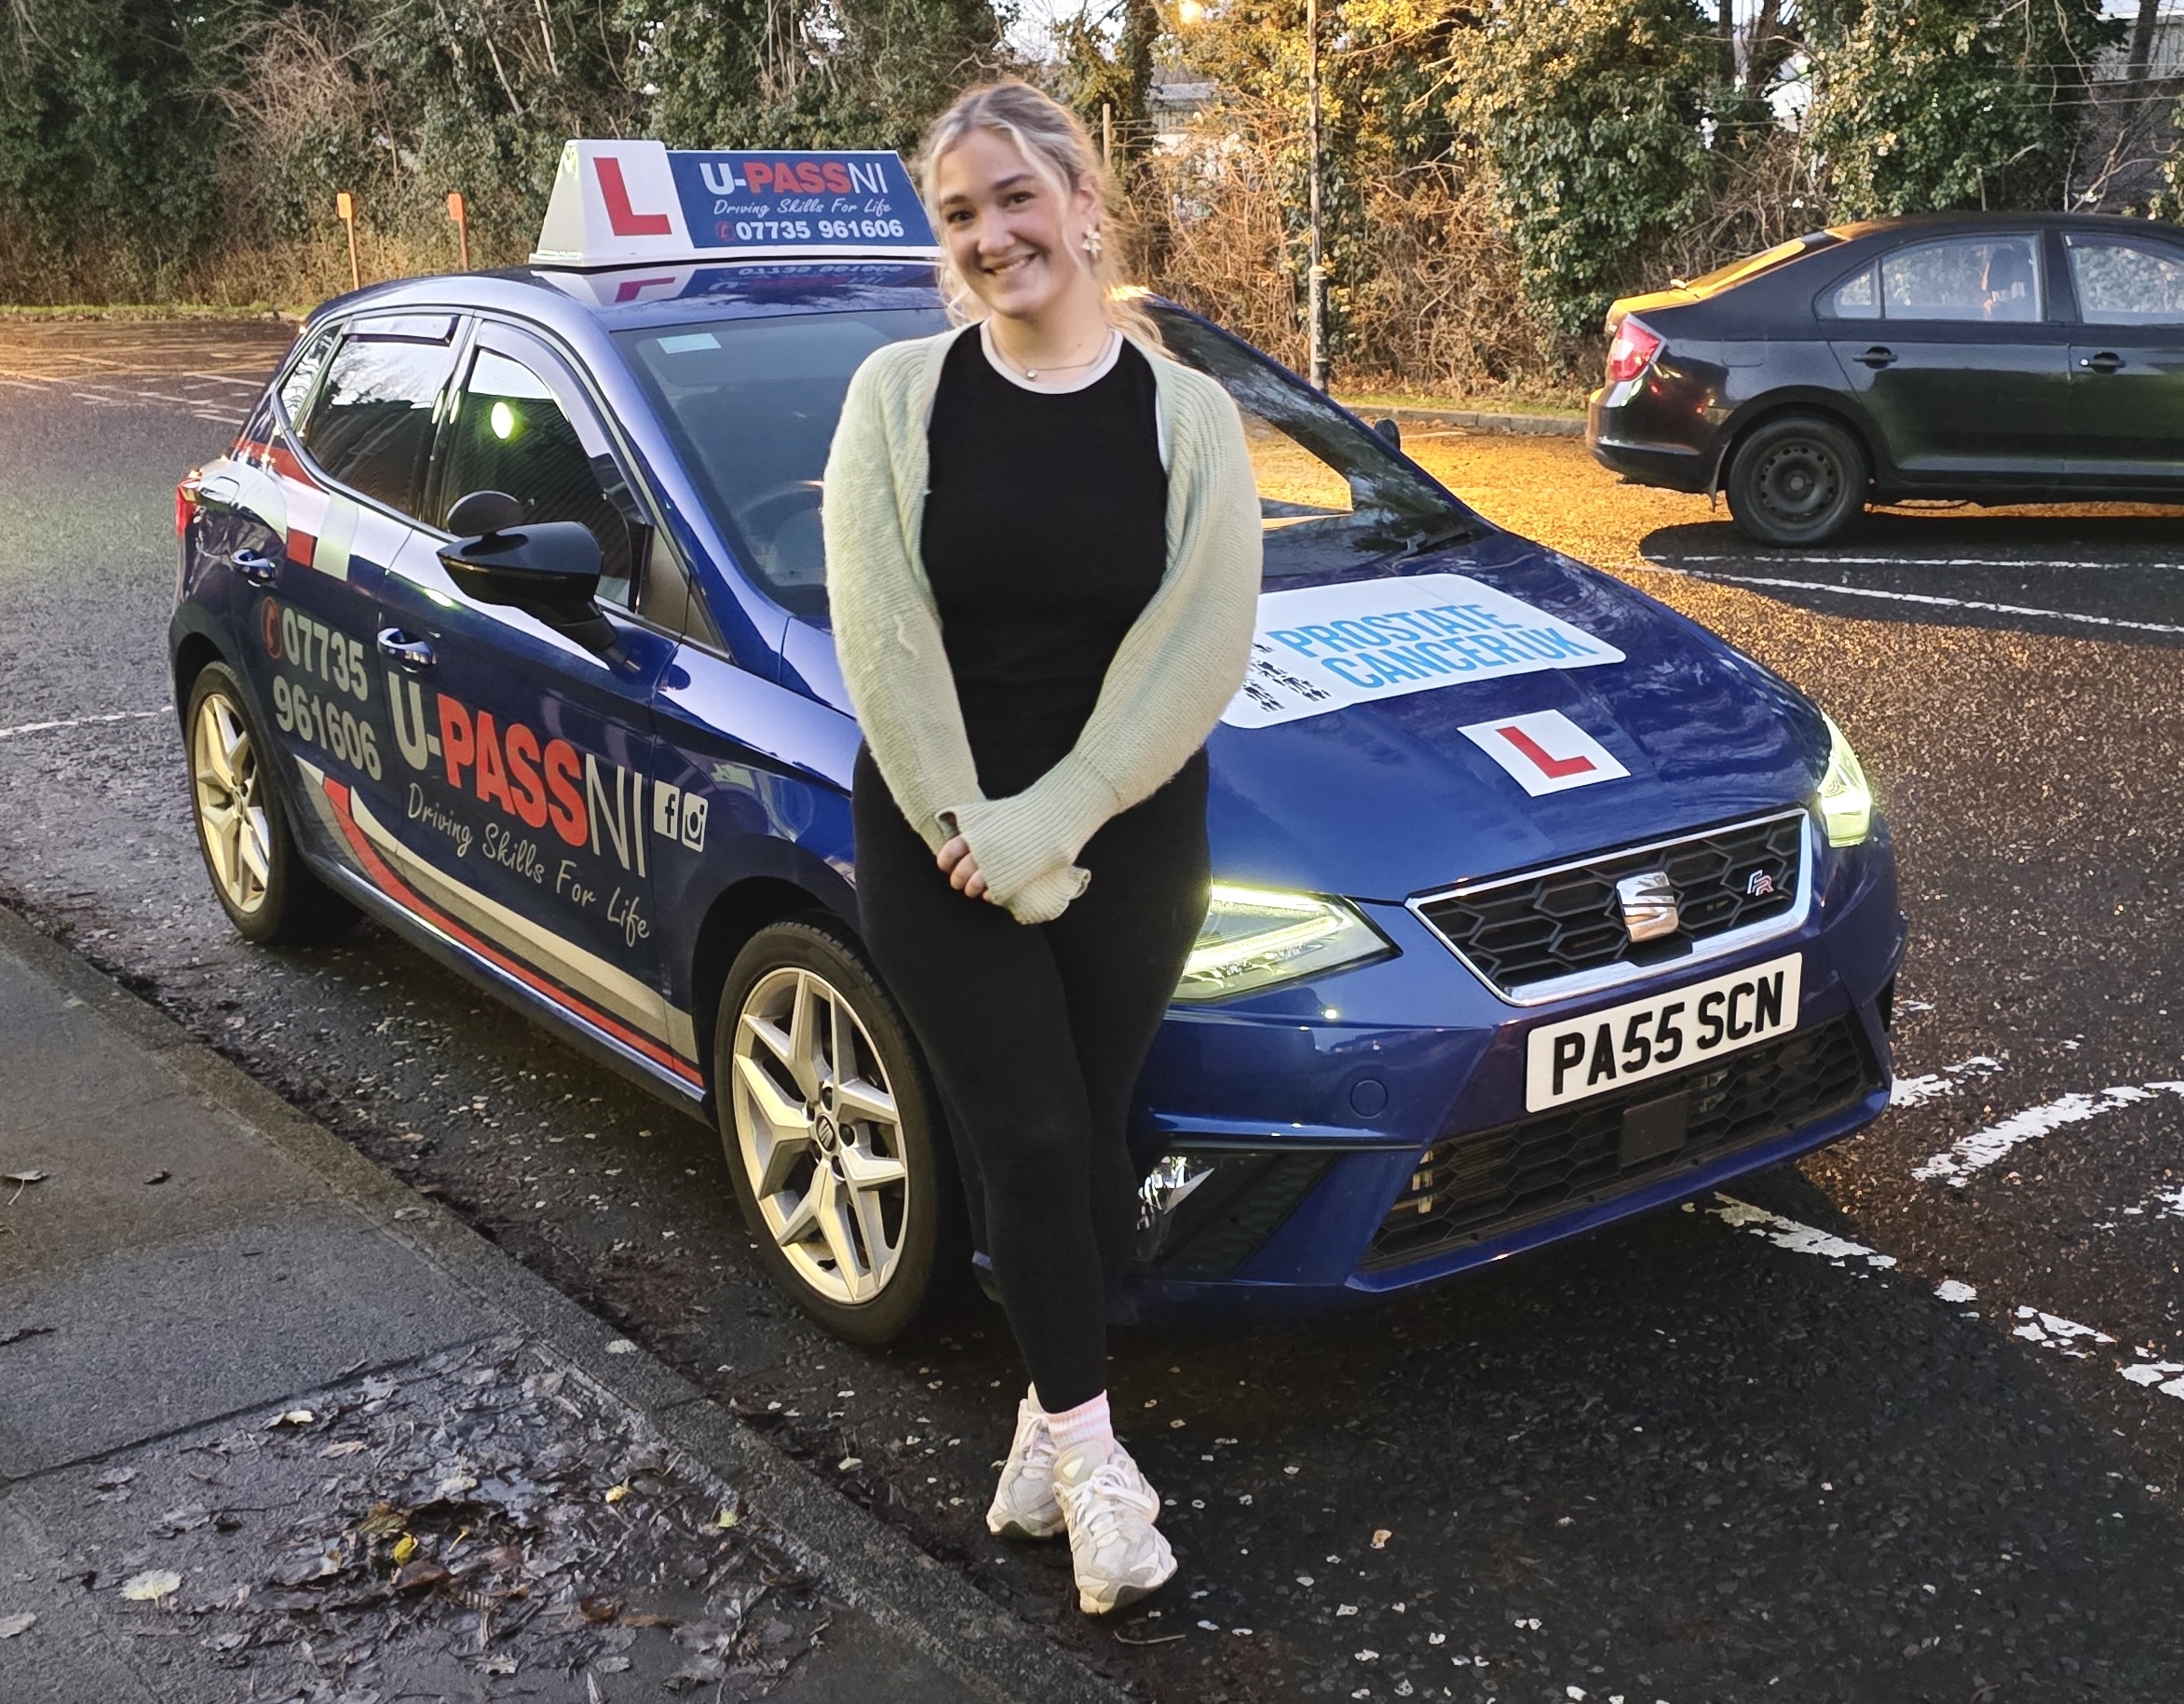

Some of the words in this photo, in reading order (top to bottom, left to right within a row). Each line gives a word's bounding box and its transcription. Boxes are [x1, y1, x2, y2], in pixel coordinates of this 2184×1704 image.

[593, 157, 672, 236] L
[699, 162, 889, 196] U-PASSNI
[713, 199, 770, 218] Driving
[777, 198, 824, 213] Skills
[831, 197, 858, 213] For
[863, 198, 892, 217] Life
[735, 221, 811, 240] 07735
[818, 220, 904, 238] 961606
[282, 608, 368, 702] 07735
[1266, 604, 1523, 658] PROSTATE
[1322, 634, 1538, 688] CANCER
[273, 676, 381, 780] 961606
[1496, 726, 1597, 779] L
[388, 671, 645, 878] U-PASSNI
[409, 782, 473, 857] Driving
[482, 822, 545, 884] Skills
[556, 860, 596, 905] For
[606, 888, 650, 948] Life
[1553, 1001, 1685, 1096] PA55
[1696, 971, 1784, 1051] SCN
